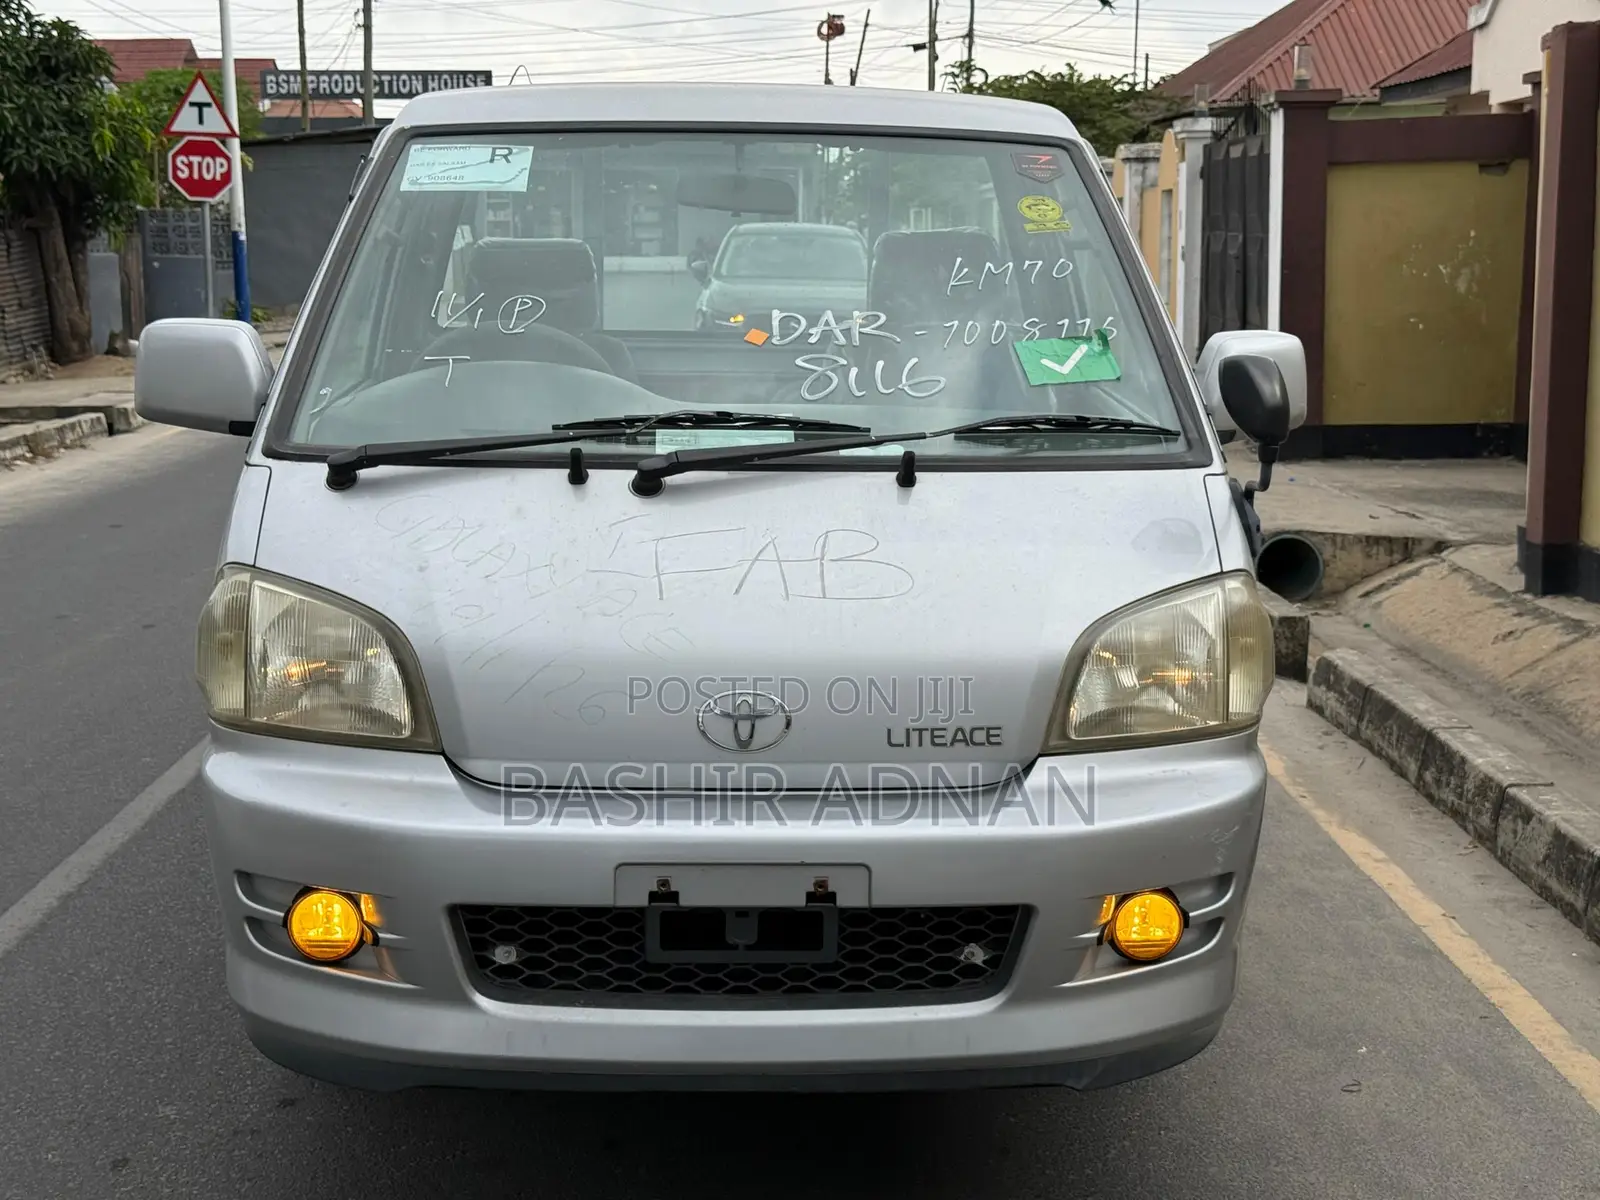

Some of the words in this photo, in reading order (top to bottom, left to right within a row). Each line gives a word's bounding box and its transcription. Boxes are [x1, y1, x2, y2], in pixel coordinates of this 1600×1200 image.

[266, 74, 301, 95] BSM
[175, 154, 229, 181] STOP
[489, 147, 514, 164] R
[947, 257, 1074, 296] KM70
[771, 309, 901, 347] DAR
[795, 353, 946, 401] 8116
[886, 727, 1003, 748] LITEACE
